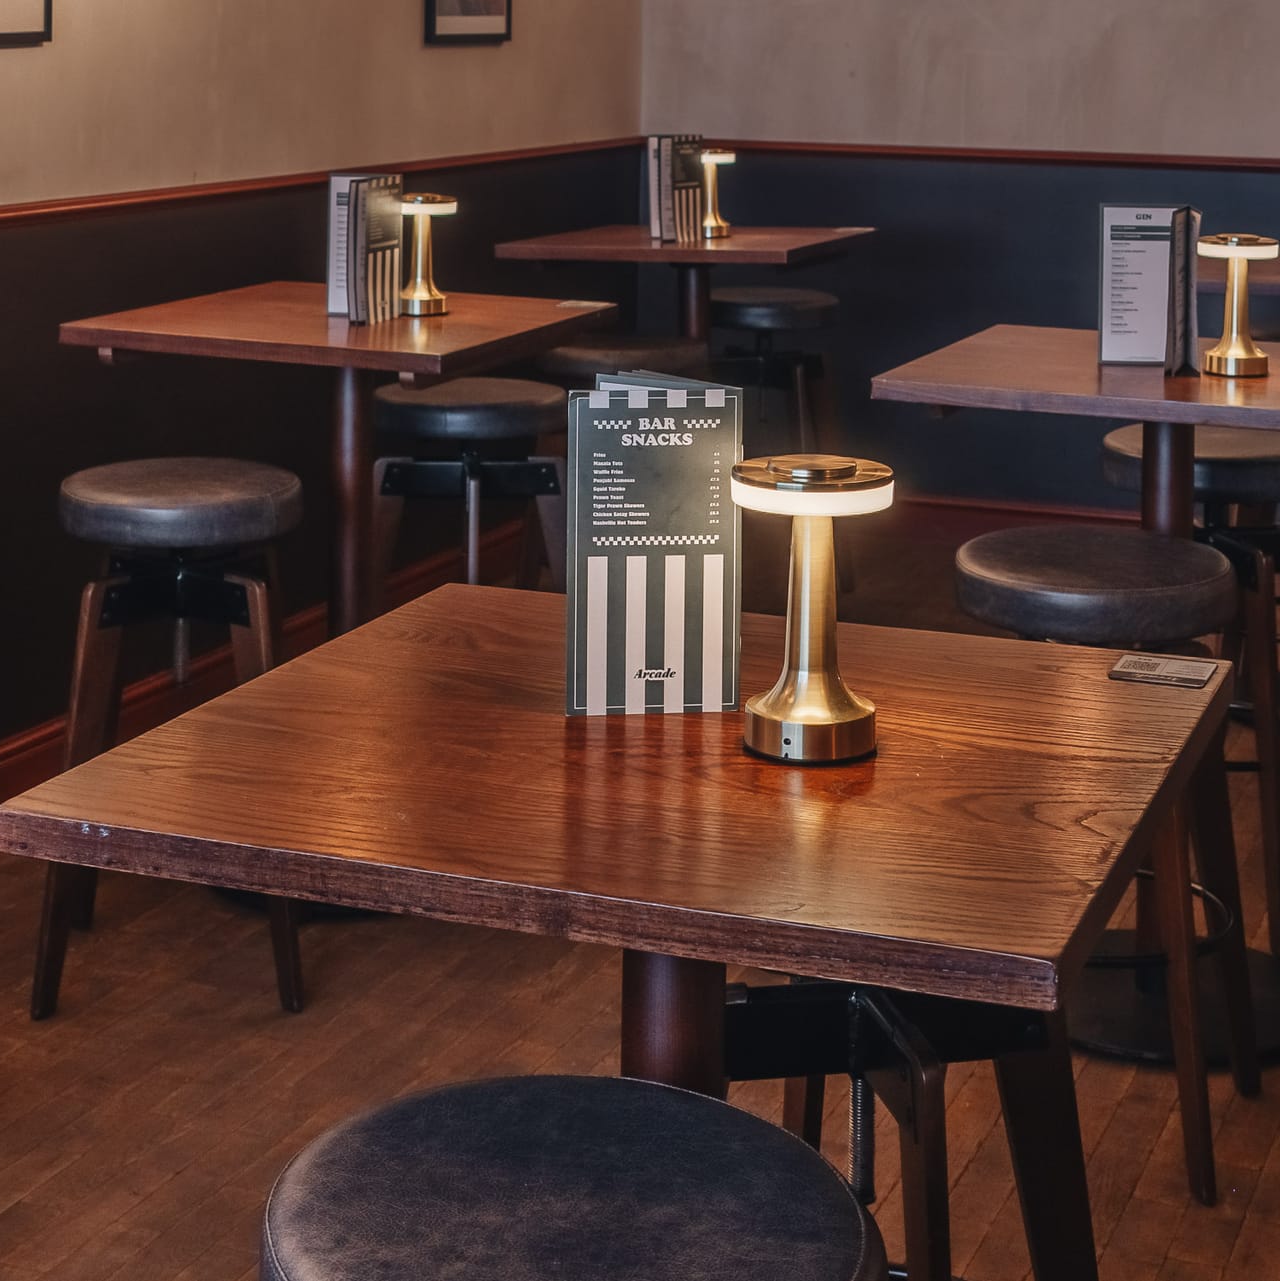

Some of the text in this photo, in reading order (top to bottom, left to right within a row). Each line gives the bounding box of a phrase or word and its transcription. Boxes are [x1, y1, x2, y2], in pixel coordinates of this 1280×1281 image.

[1135, 213, 1152, 221] GIN
[638, 417, 676, 431] BAR
[621, 433, 693, 447] SNACKS
[633, 668, 676, 680] Arcade
